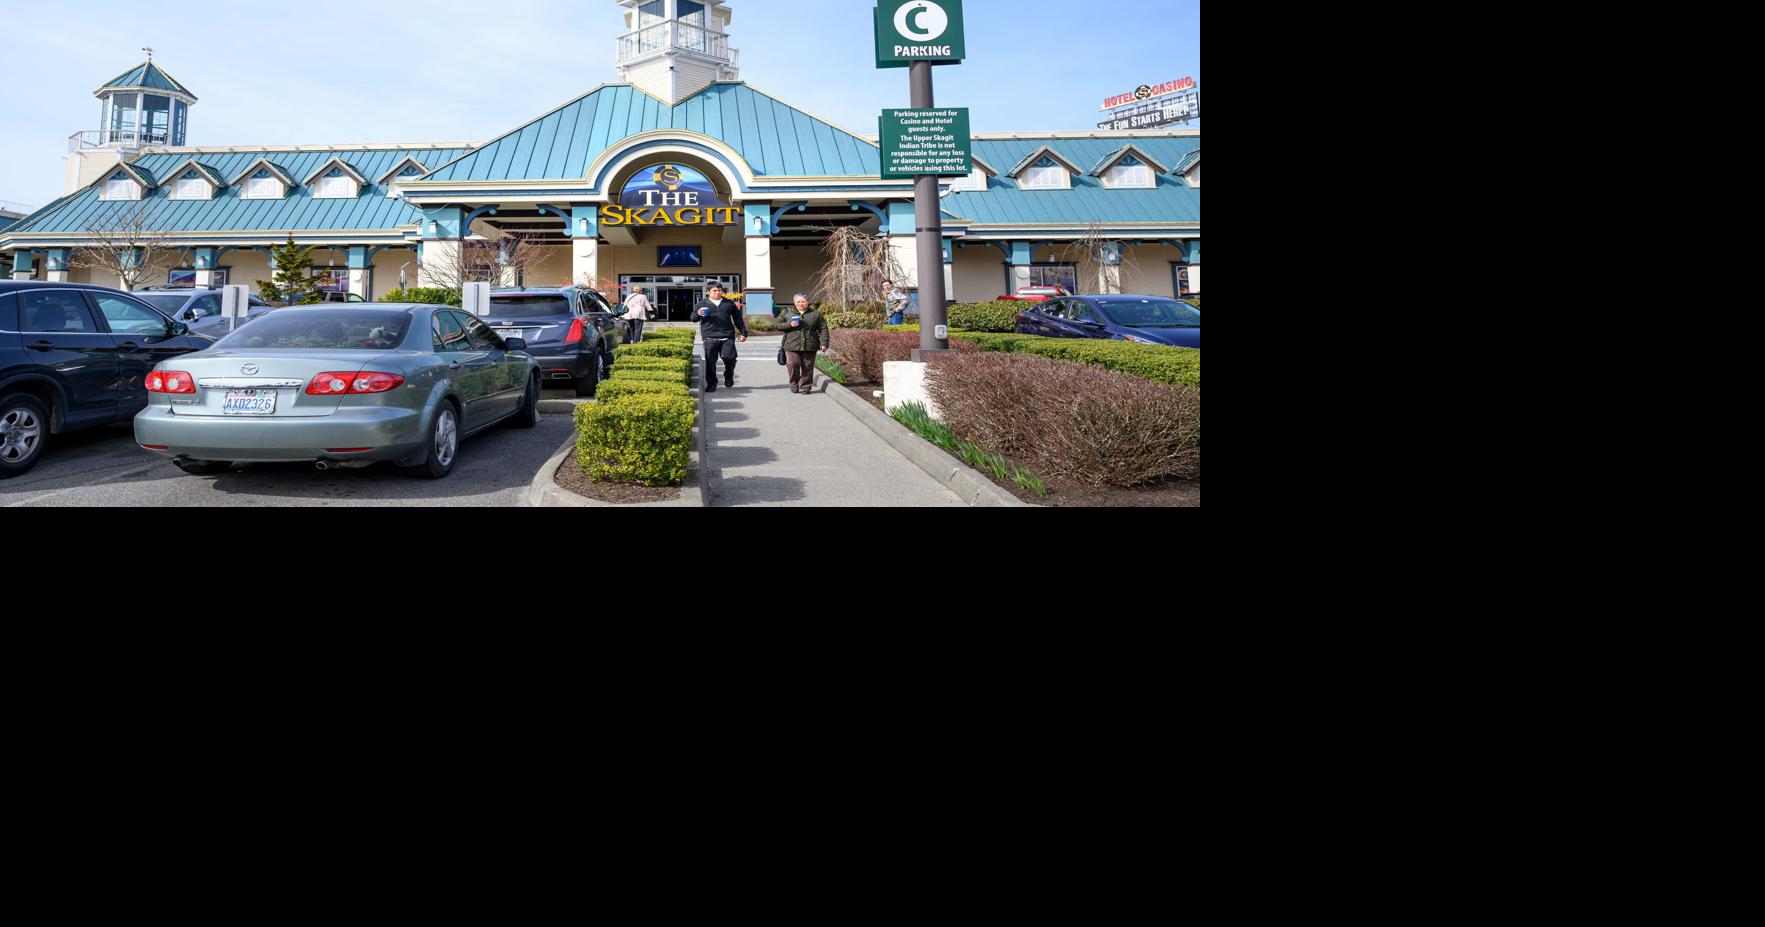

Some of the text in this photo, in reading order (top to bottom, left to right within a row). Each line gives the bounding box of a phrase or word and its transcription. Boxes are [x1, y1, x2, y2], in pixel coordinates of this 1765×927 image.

[905, 6, 929, 35] C
[894, 45, 951, 57] PARKING
[1103, 92, 1136, 108] HOTEL
[1152, 76, 1193, 96] CASINO
[1131, 111, 1161, 127] STARTS
[929, 125, 946, 133] only.
[933, 134, 954, 142] Skagit
[890, 149, 928, 157] responsible
[639, 189, 699, 207] THE
[601, 204, 740, 225] SKAGIT
